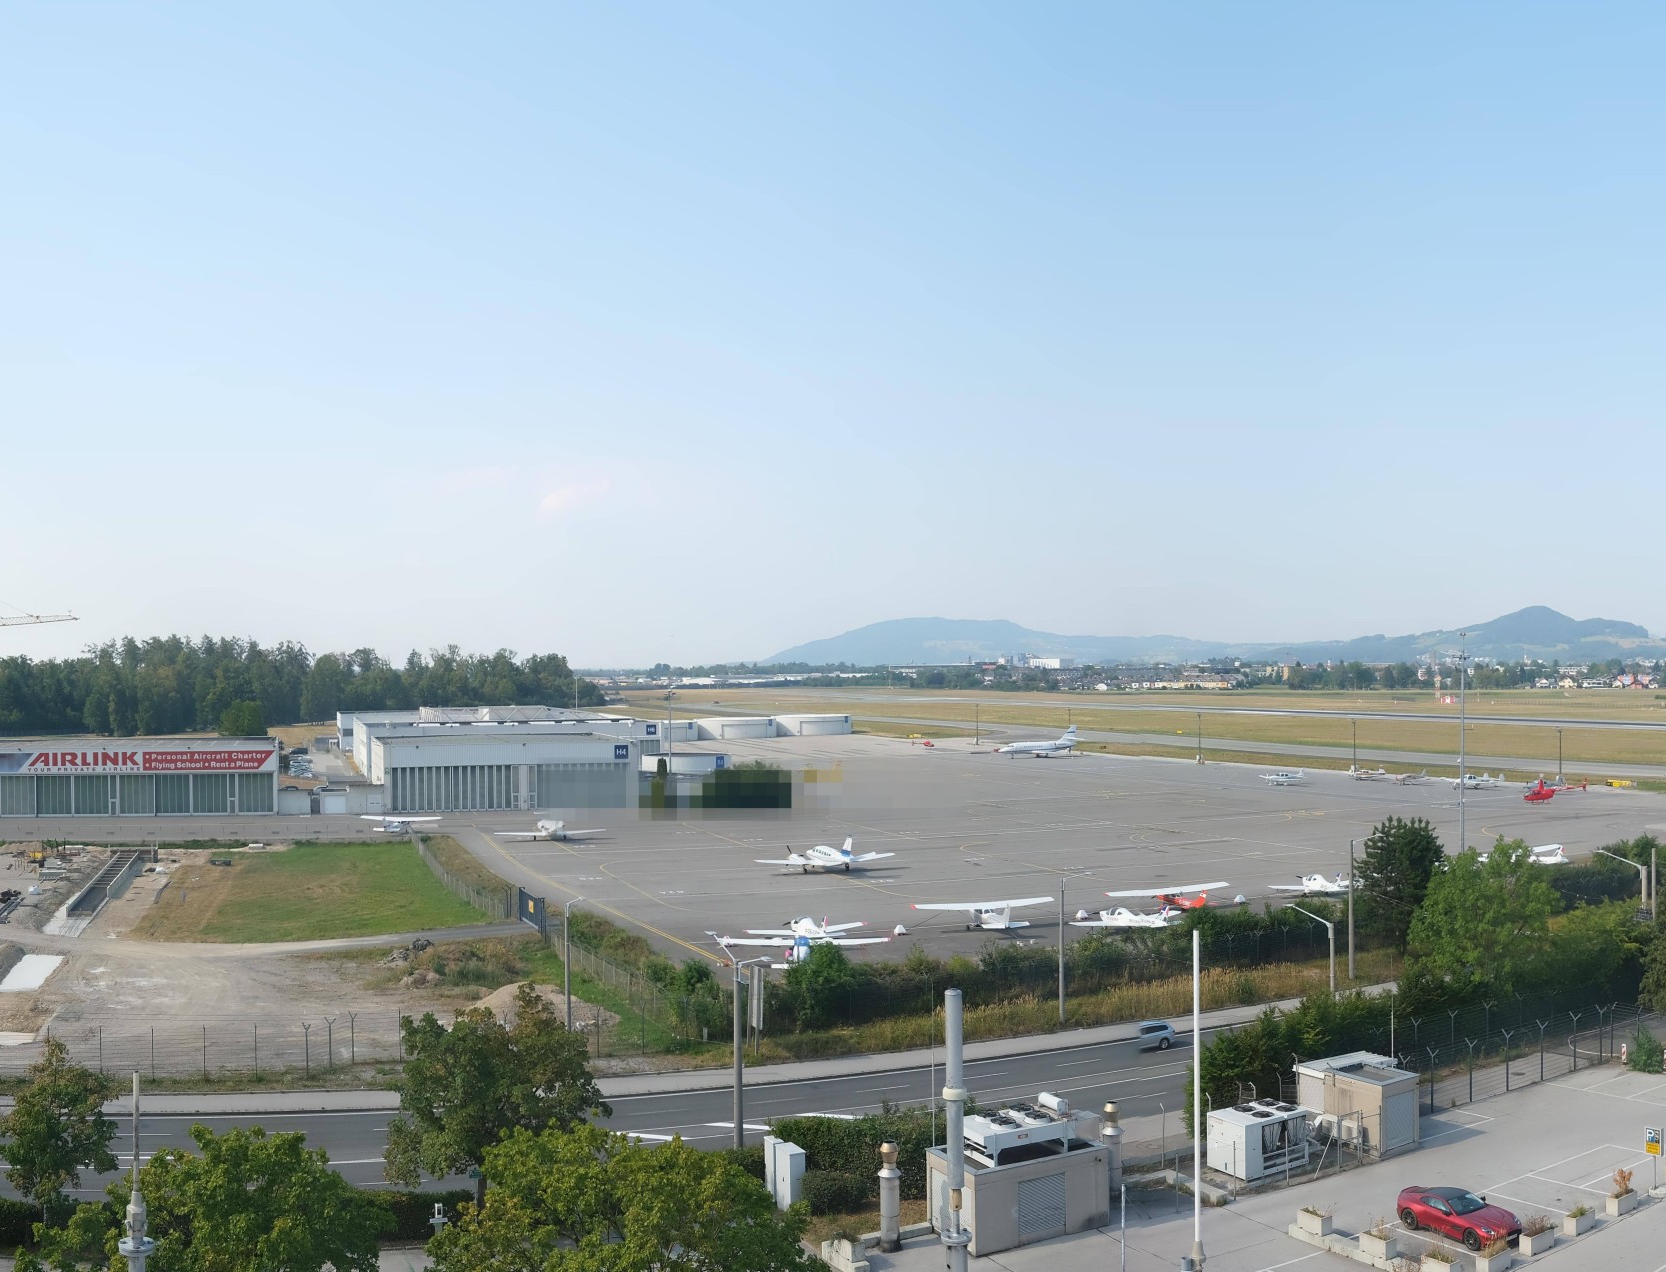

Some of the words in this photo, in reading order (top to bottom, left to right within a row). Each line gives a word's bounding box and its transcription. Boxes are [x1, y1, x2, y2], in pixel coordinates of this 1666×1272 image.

[193, 752, 229, 760] Aircraft
[231, 751, 266, 759] Charter
[616, 748, 627, 756] H4
[28, 751, 140, 767] AIRLINK
[151, 761, 176, 770] Flying
[176, 760, 203, 768] School
[210, 760, 230, 769] Rent
[236, 760, 259, 768] Plane
